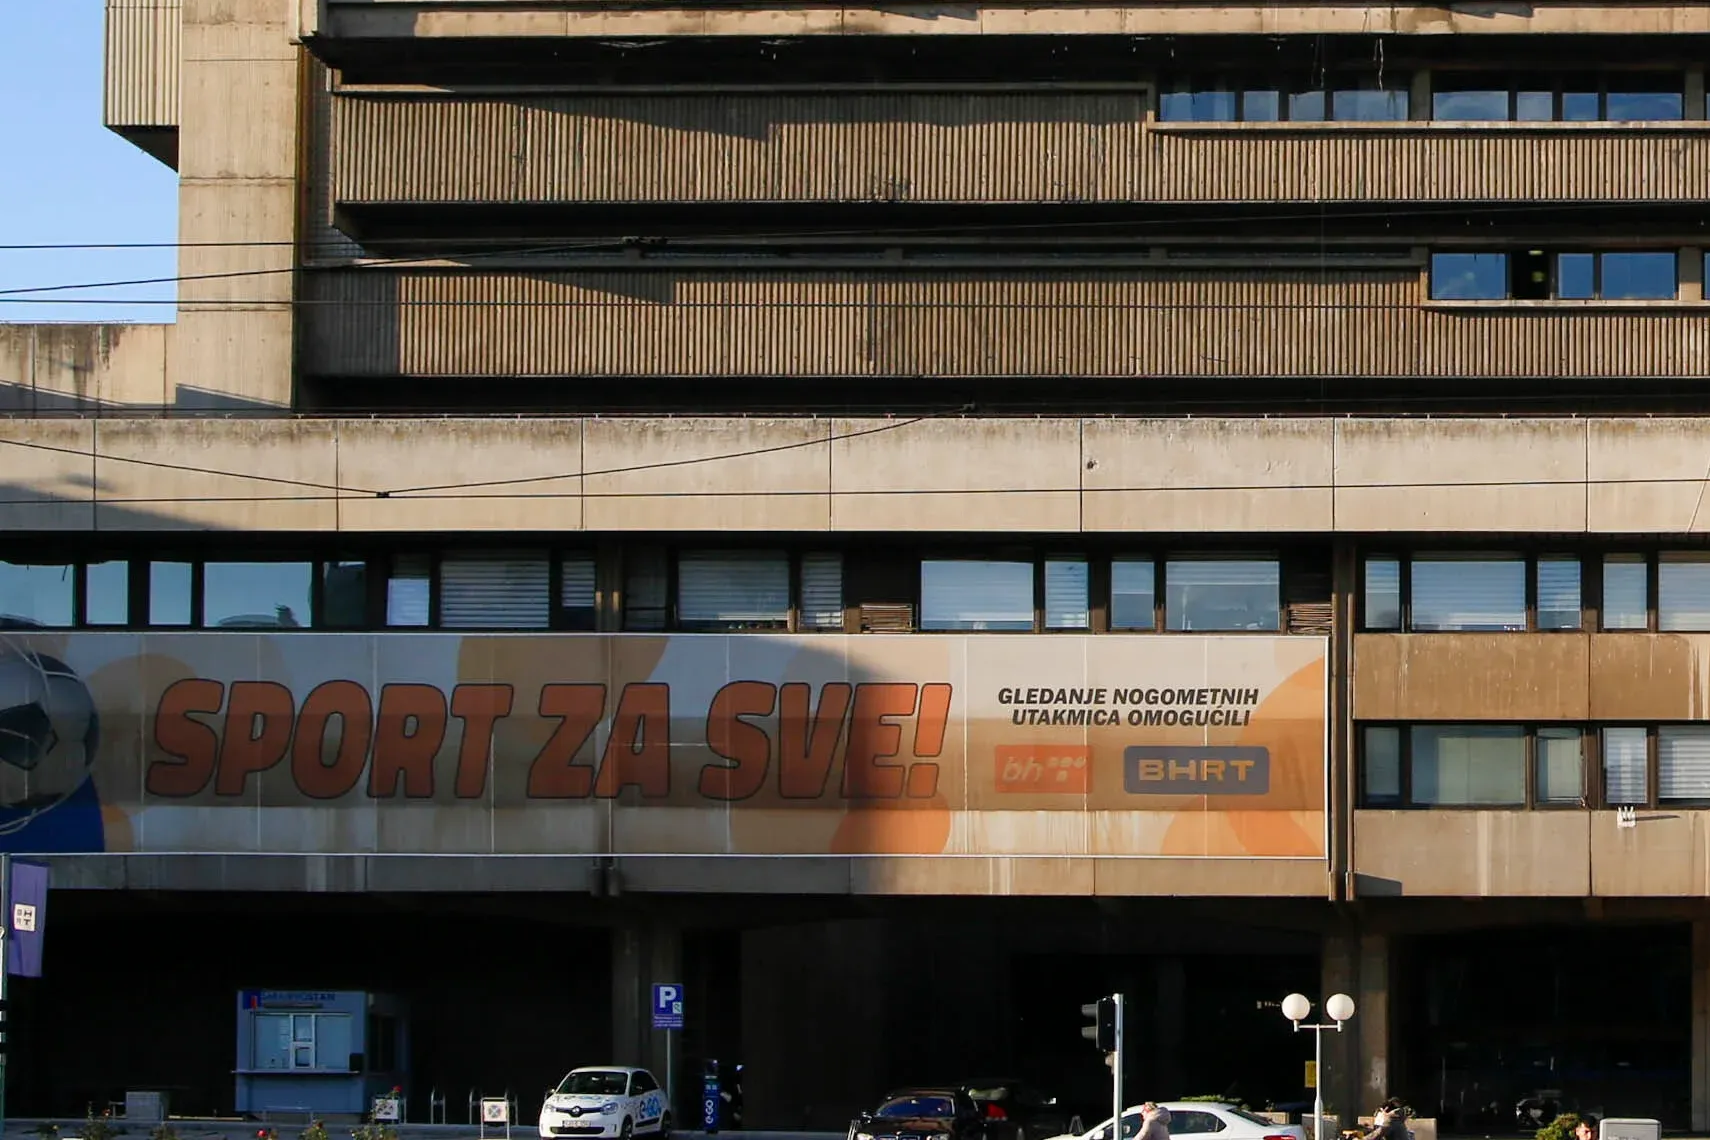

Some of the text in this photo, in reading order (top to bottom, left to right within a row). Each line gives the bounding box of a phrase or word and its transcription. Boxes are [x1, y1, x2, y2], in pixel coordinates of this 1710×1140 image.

[998, 688, 1259, 705] GLEDANJE NOGOMETNIH
[1012, 705, 1250, 727] UTAKMICA OMOGUĆILI
[145, 678, 953, 800] SPORT ZA SVE!
[1137, 759, 1255, 781] BHRT
[659, 986, 677, 1008] P
